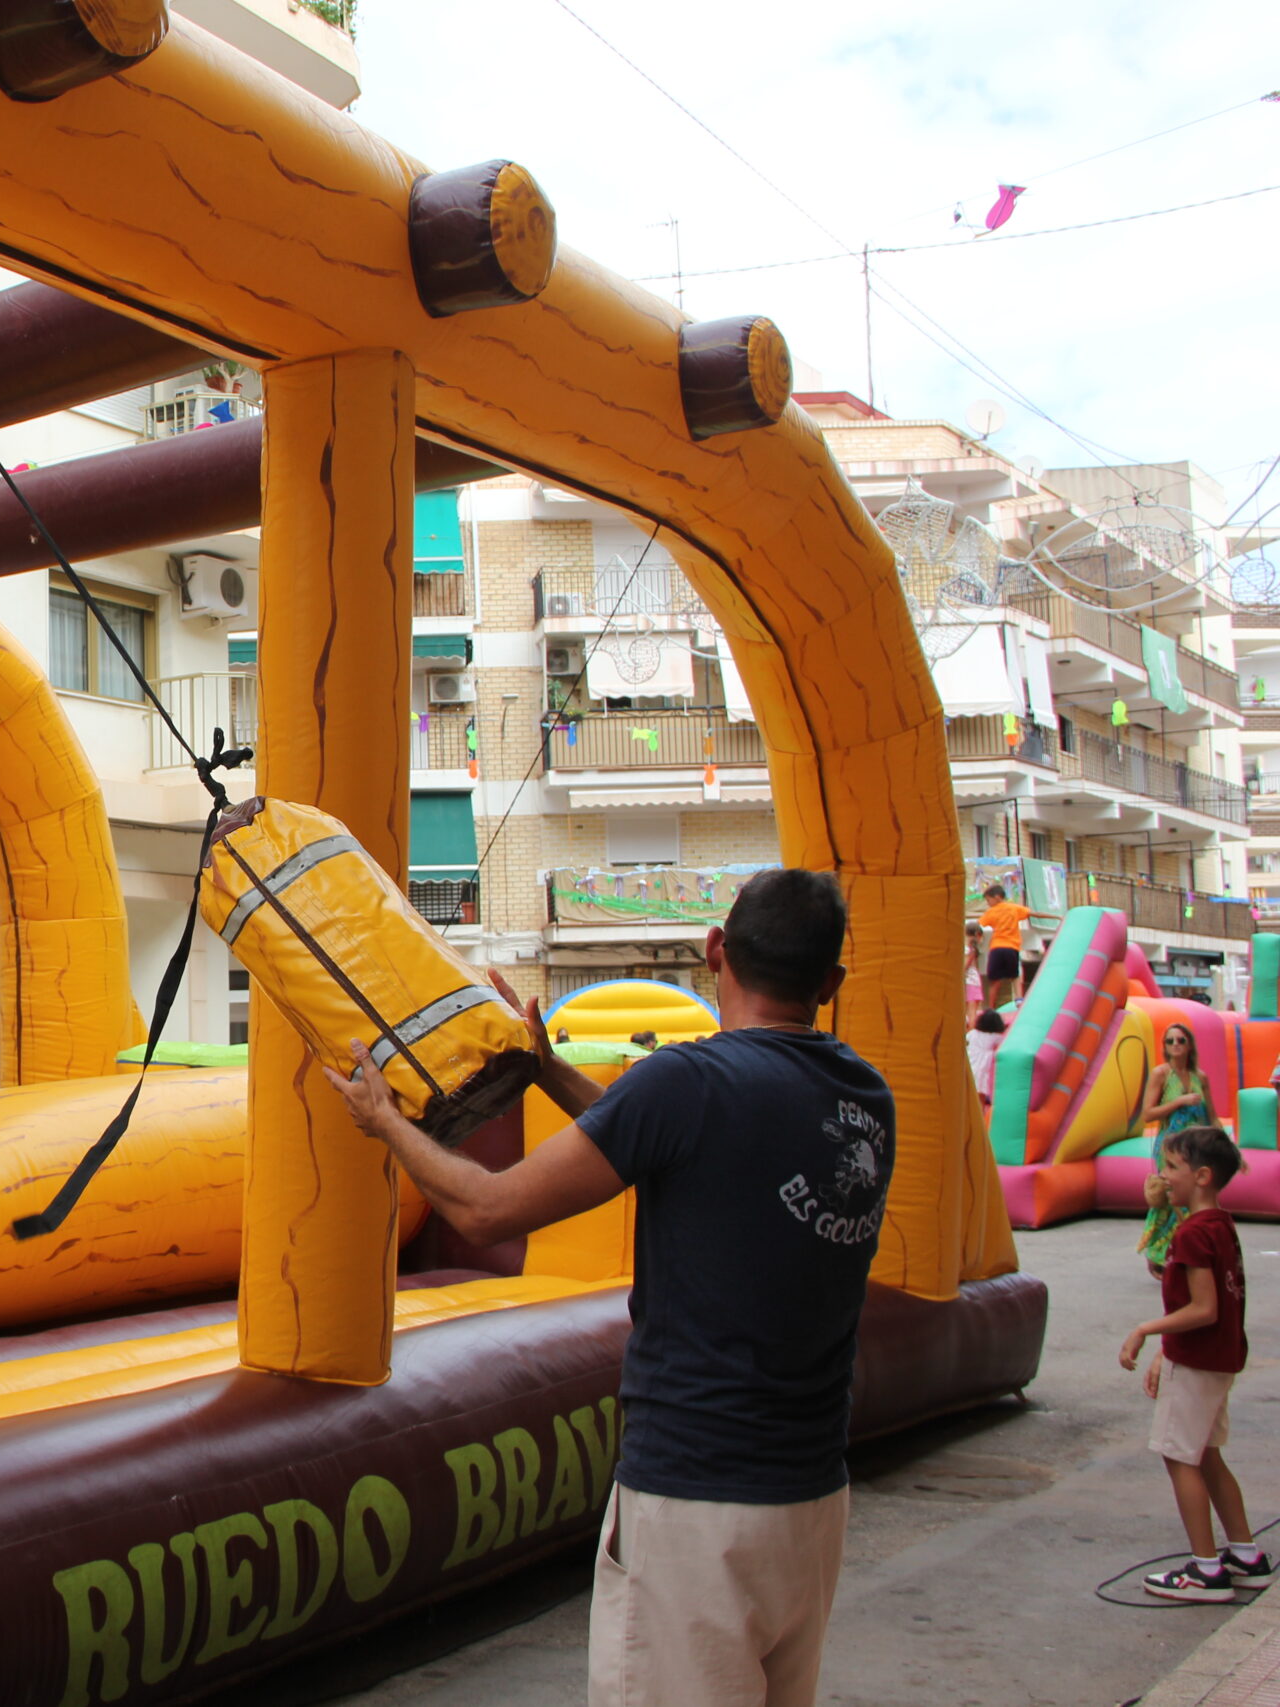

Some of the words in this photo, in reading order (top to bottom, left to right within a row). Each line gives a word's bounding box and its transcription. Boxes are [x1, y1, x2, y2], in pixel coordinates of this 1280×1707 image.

[779, 1173, 818, 1222] ELS
[53, 1474, 412, 1707] RUEDO
[441, 1396, 625, 1571] BRAV
